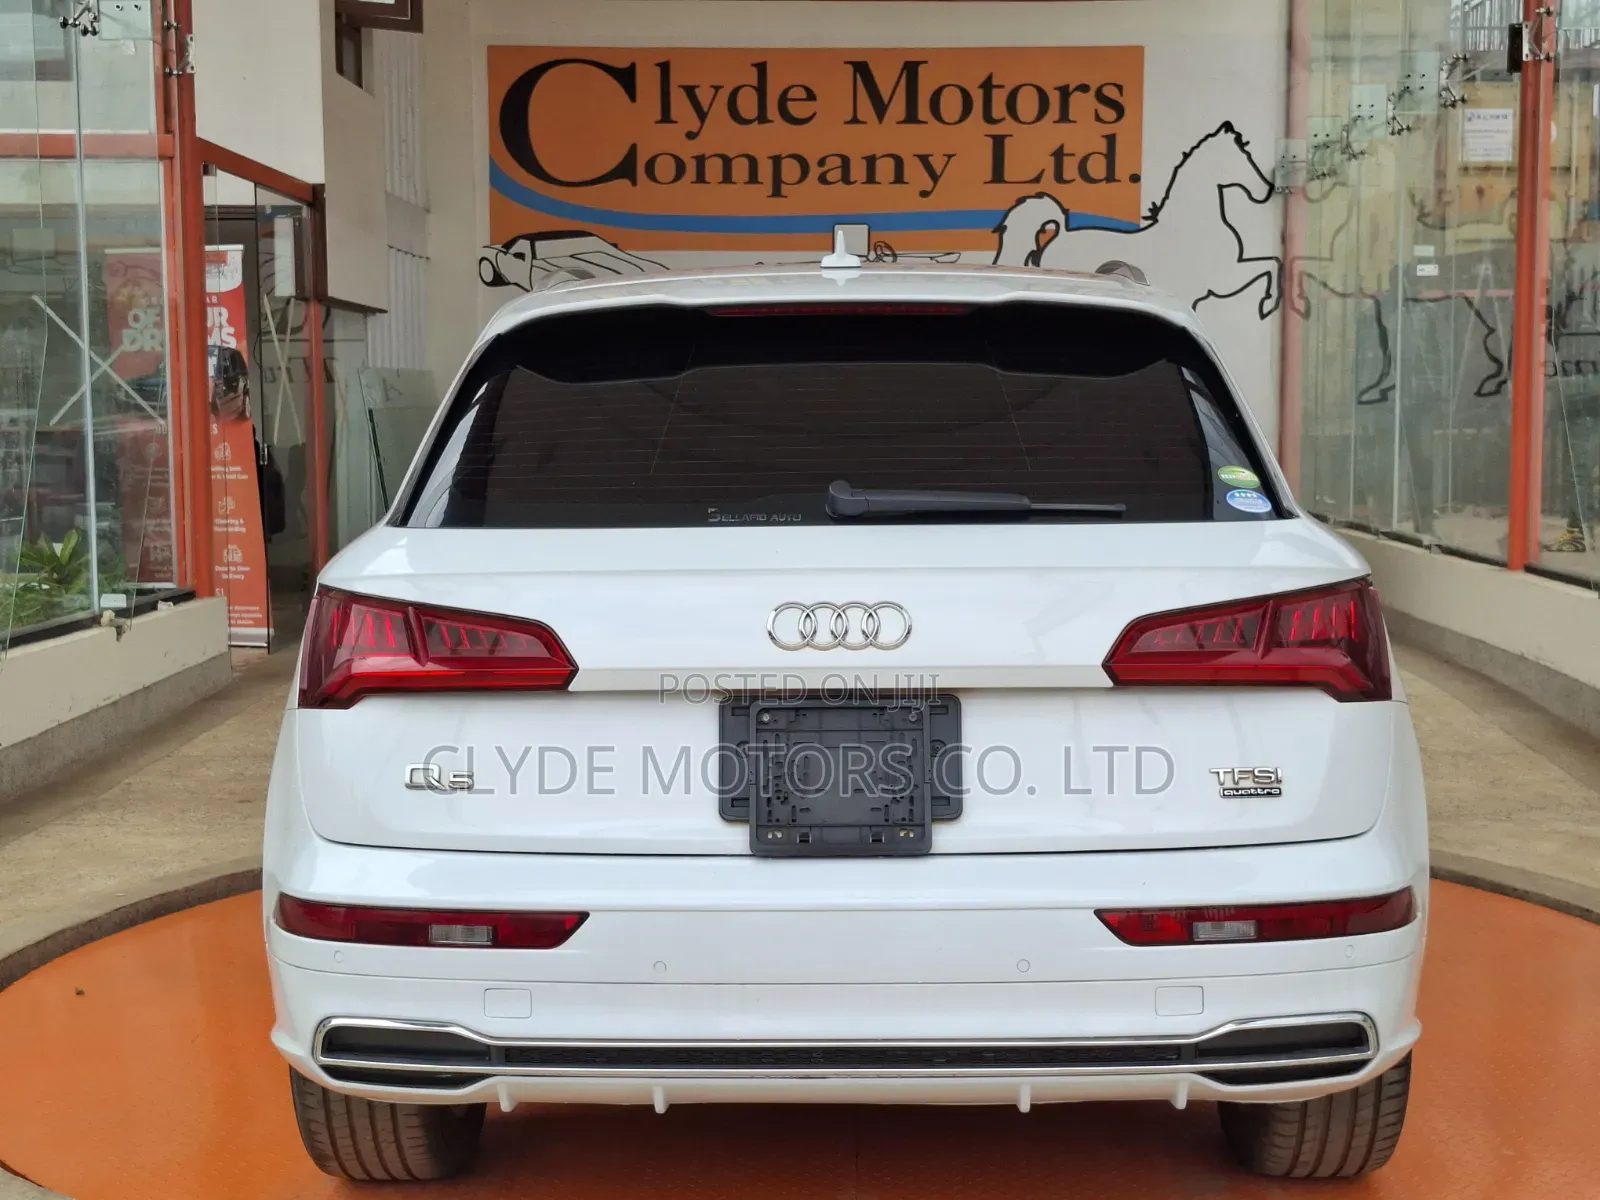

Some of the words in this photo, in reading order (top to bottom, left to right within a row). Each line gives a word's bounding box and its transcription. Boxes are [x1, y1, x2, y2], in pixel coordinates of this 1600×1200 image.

[843, 60, 1125, 126] Motors
[983, 132, 1141, 185] Ltd.
[1209, 767, 1283, 786] TFSI
[1223, 788, 1280, 796] quattro
